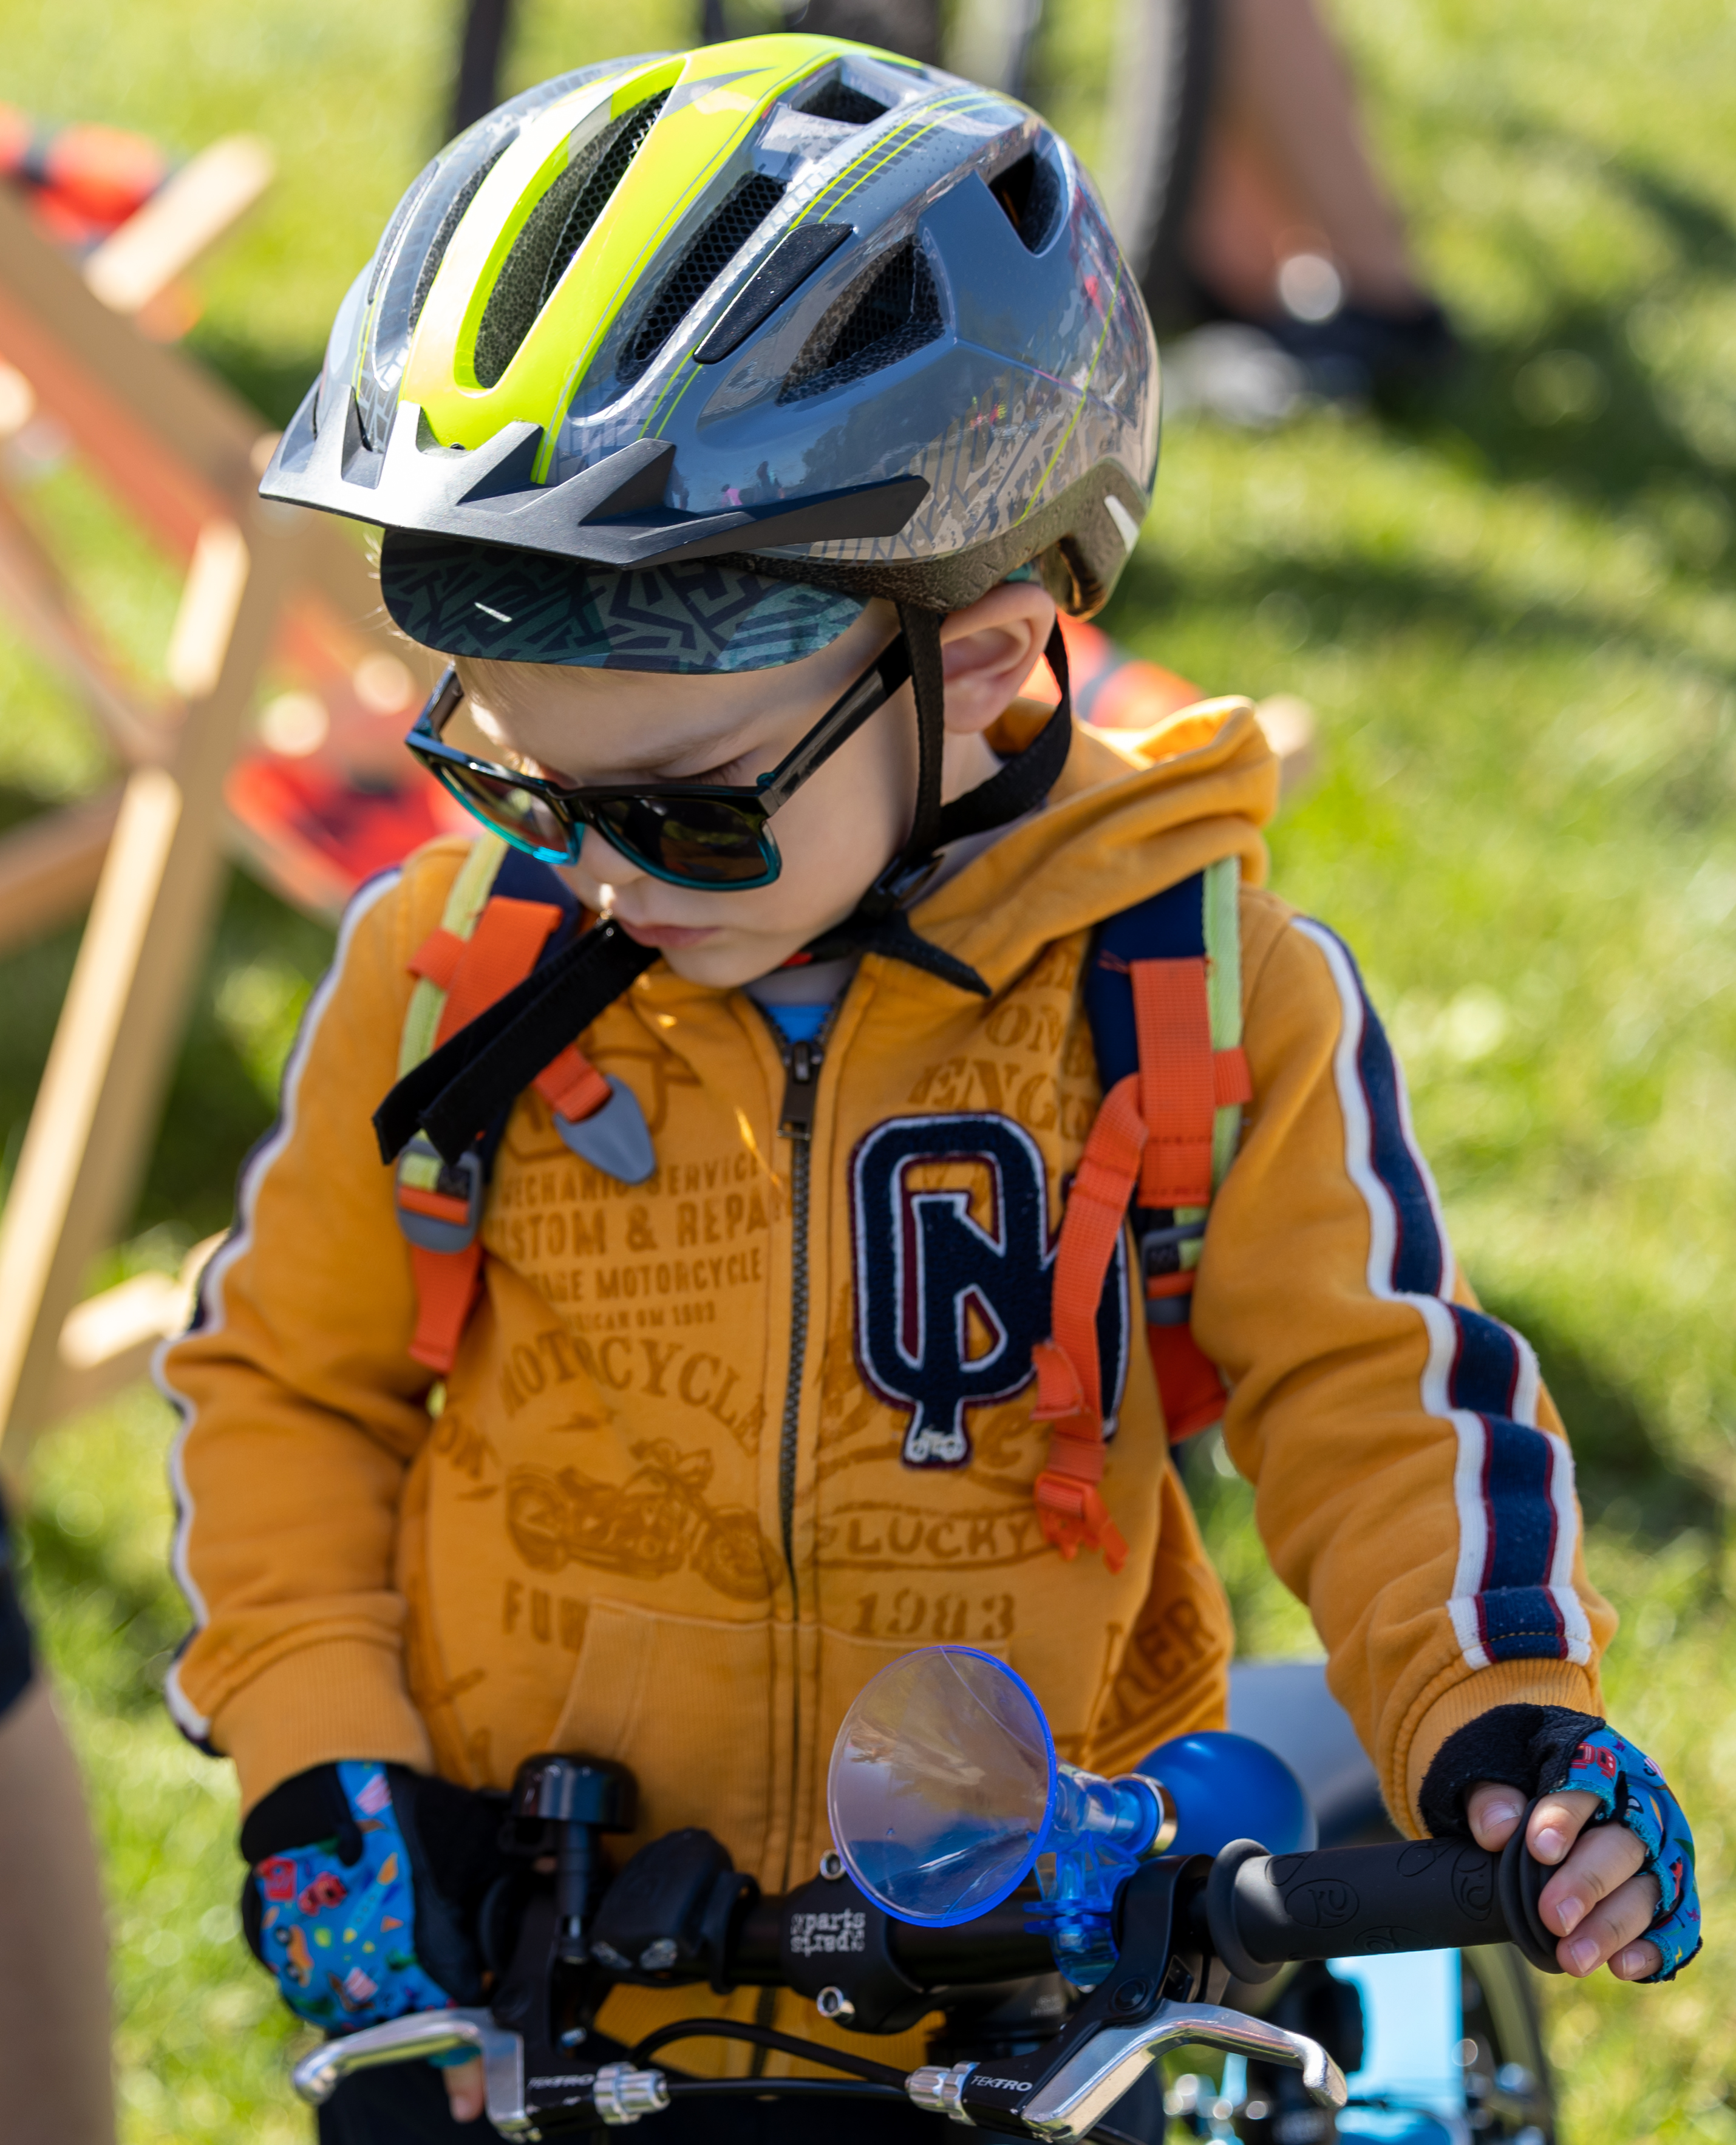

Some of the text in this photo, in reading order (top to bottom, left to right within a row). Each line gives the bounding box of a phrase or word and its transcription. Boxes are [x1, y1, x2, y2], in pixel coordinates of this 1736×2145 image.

[625, 1203, 658, 1251] &
[596, 1248, 762, 1299] MOTORCYCLE
[847, 1515, 1033, 1559] LUCKY
[853, 1587, 1015, 1640] 1983
[971, 2075, 1032, 2092] TEKTRO
